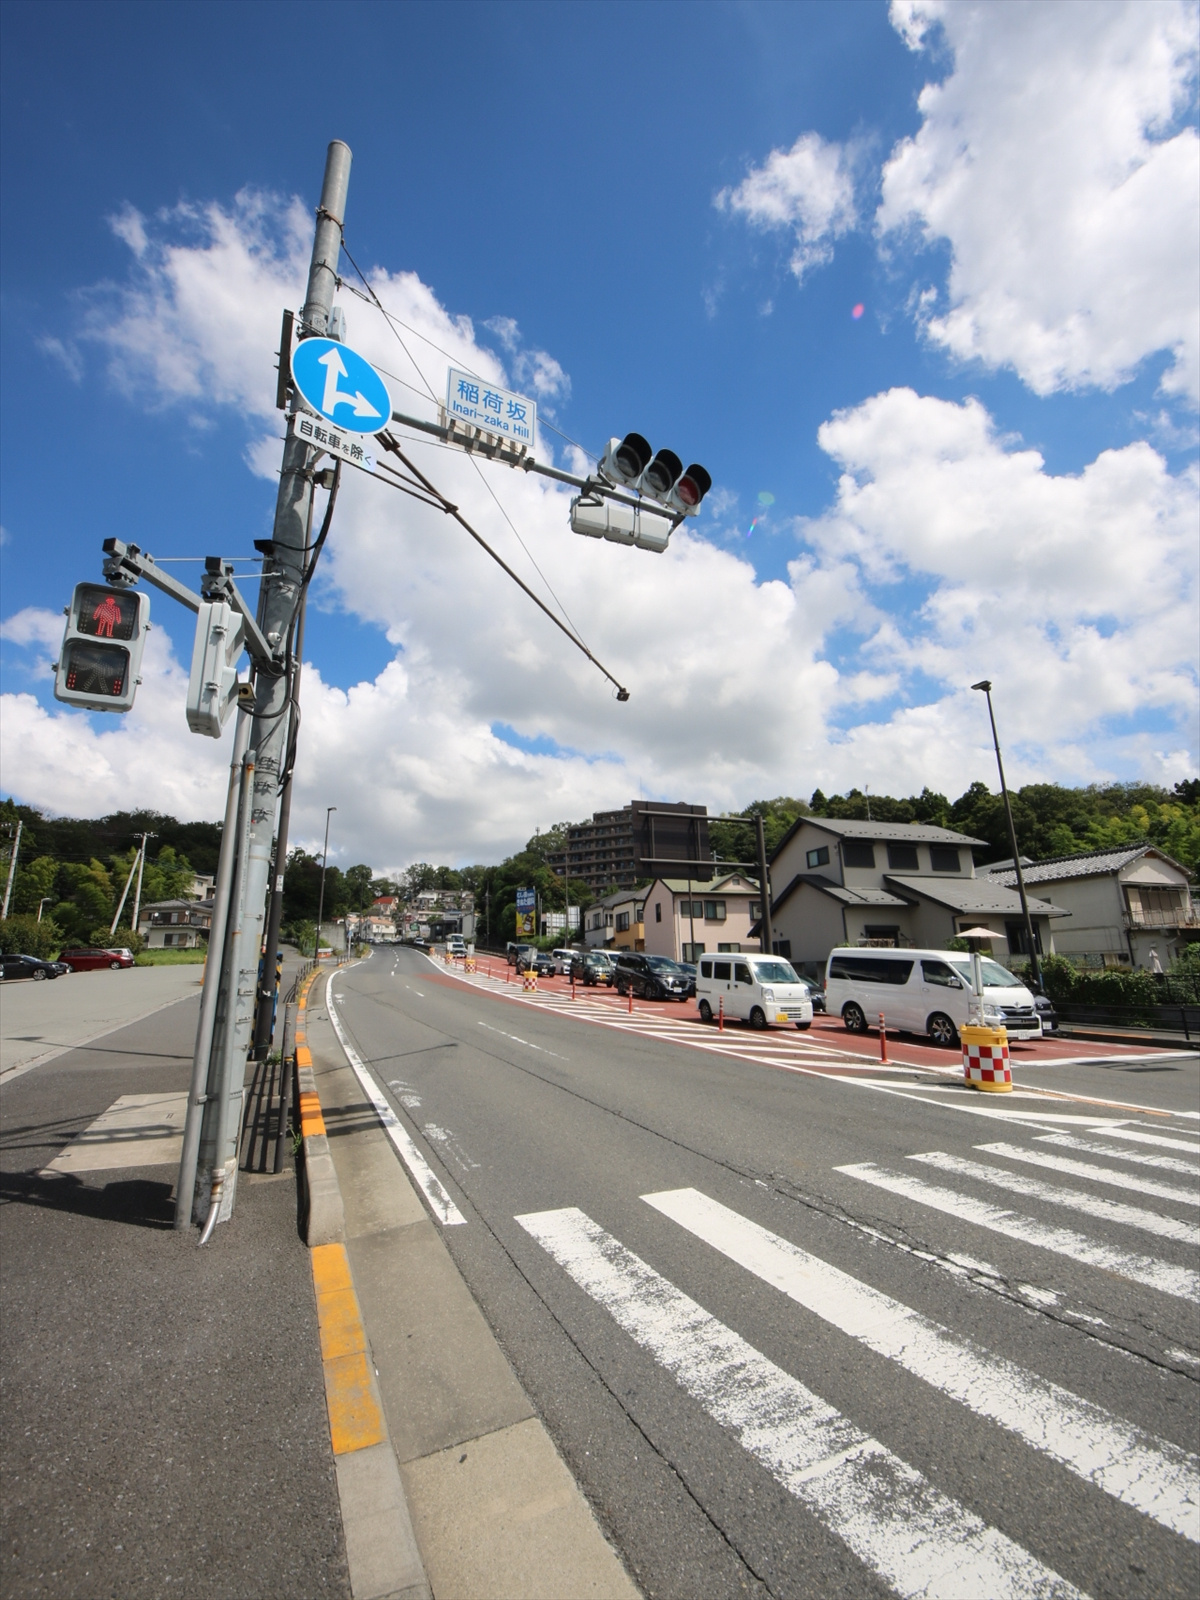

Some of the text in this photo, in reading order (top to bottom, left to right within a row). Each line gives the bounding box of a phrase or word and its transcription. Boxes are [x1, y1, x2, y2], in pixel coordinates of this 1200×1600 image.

[452, 400, 530, 439] Inari-zaka Hill
[457, 379, 527, 424] 稲荷坂
[300, 420, 372, 466] 自転車を除く
